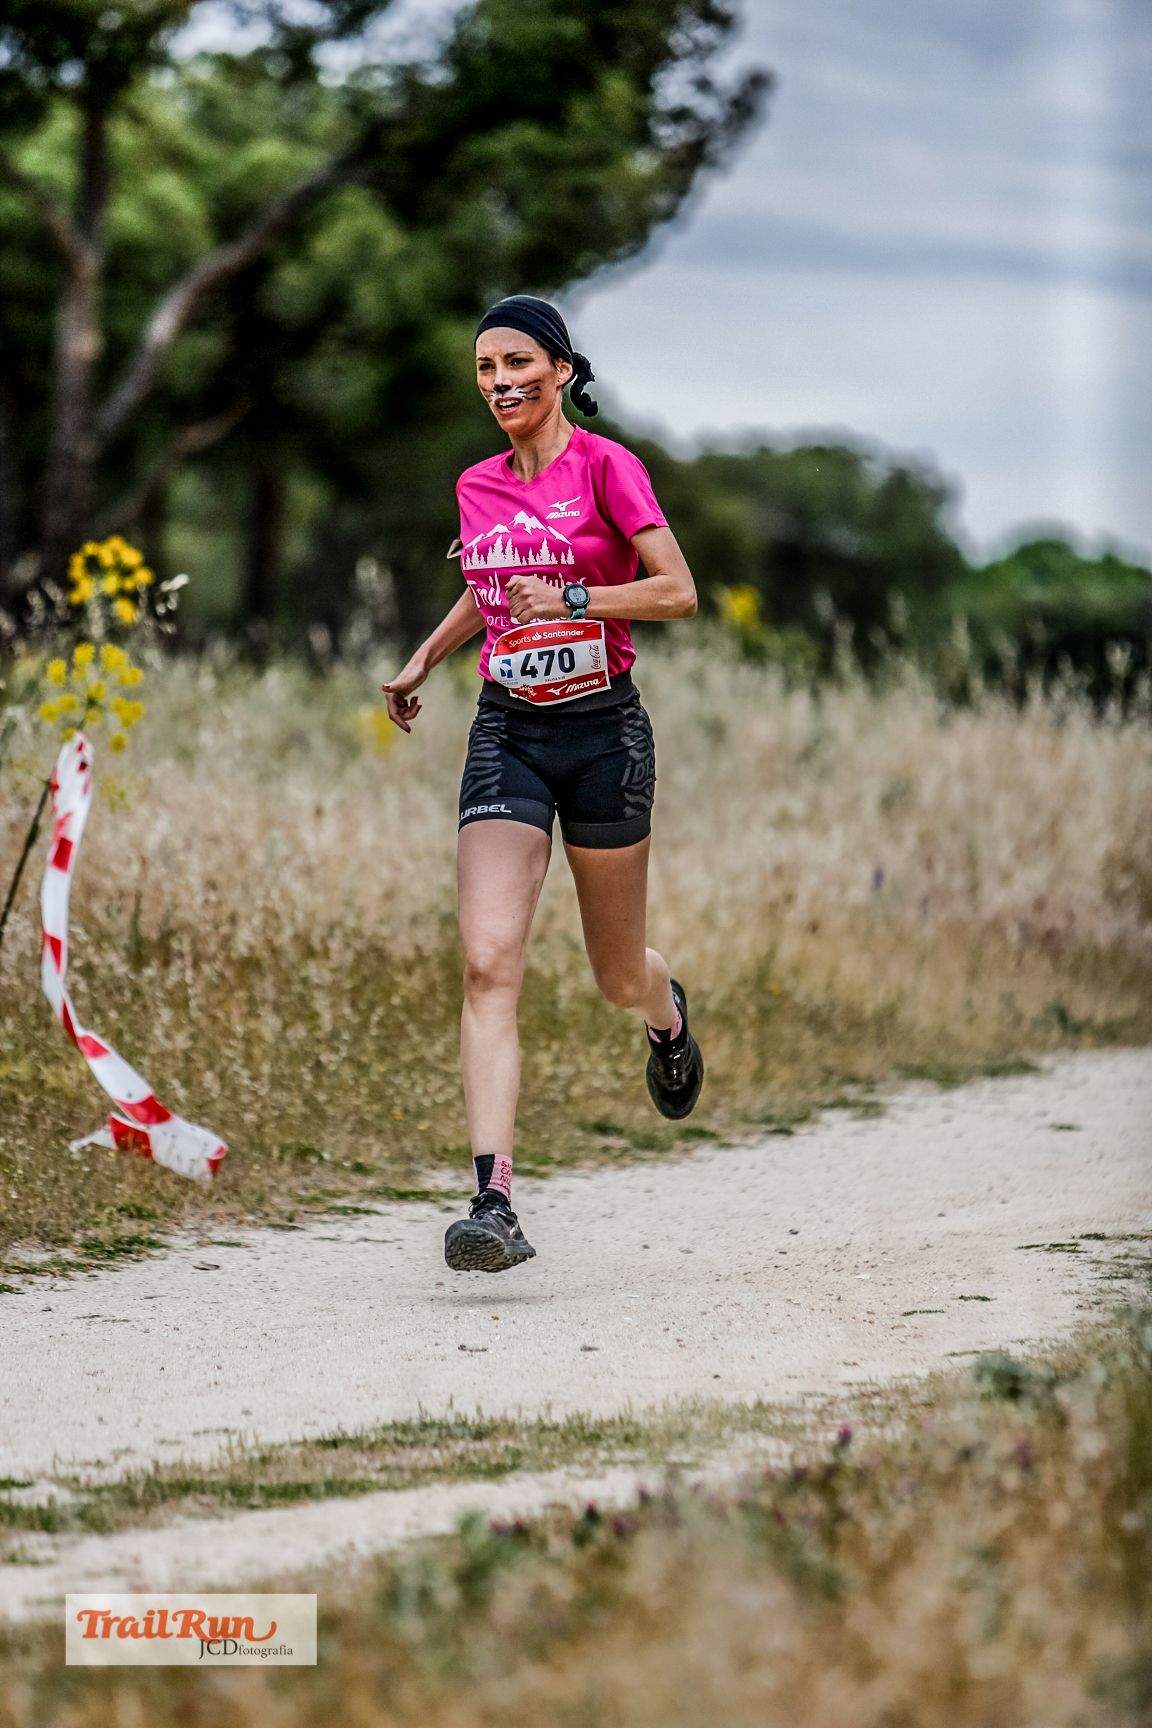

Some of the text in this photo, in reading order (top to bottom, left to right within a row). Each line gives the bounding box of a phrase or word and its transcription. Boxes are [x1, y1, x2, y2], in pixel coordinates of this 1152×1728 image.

[508, 629, 584, 648] Sports Santander
[520, 647, 575, 678] 470
